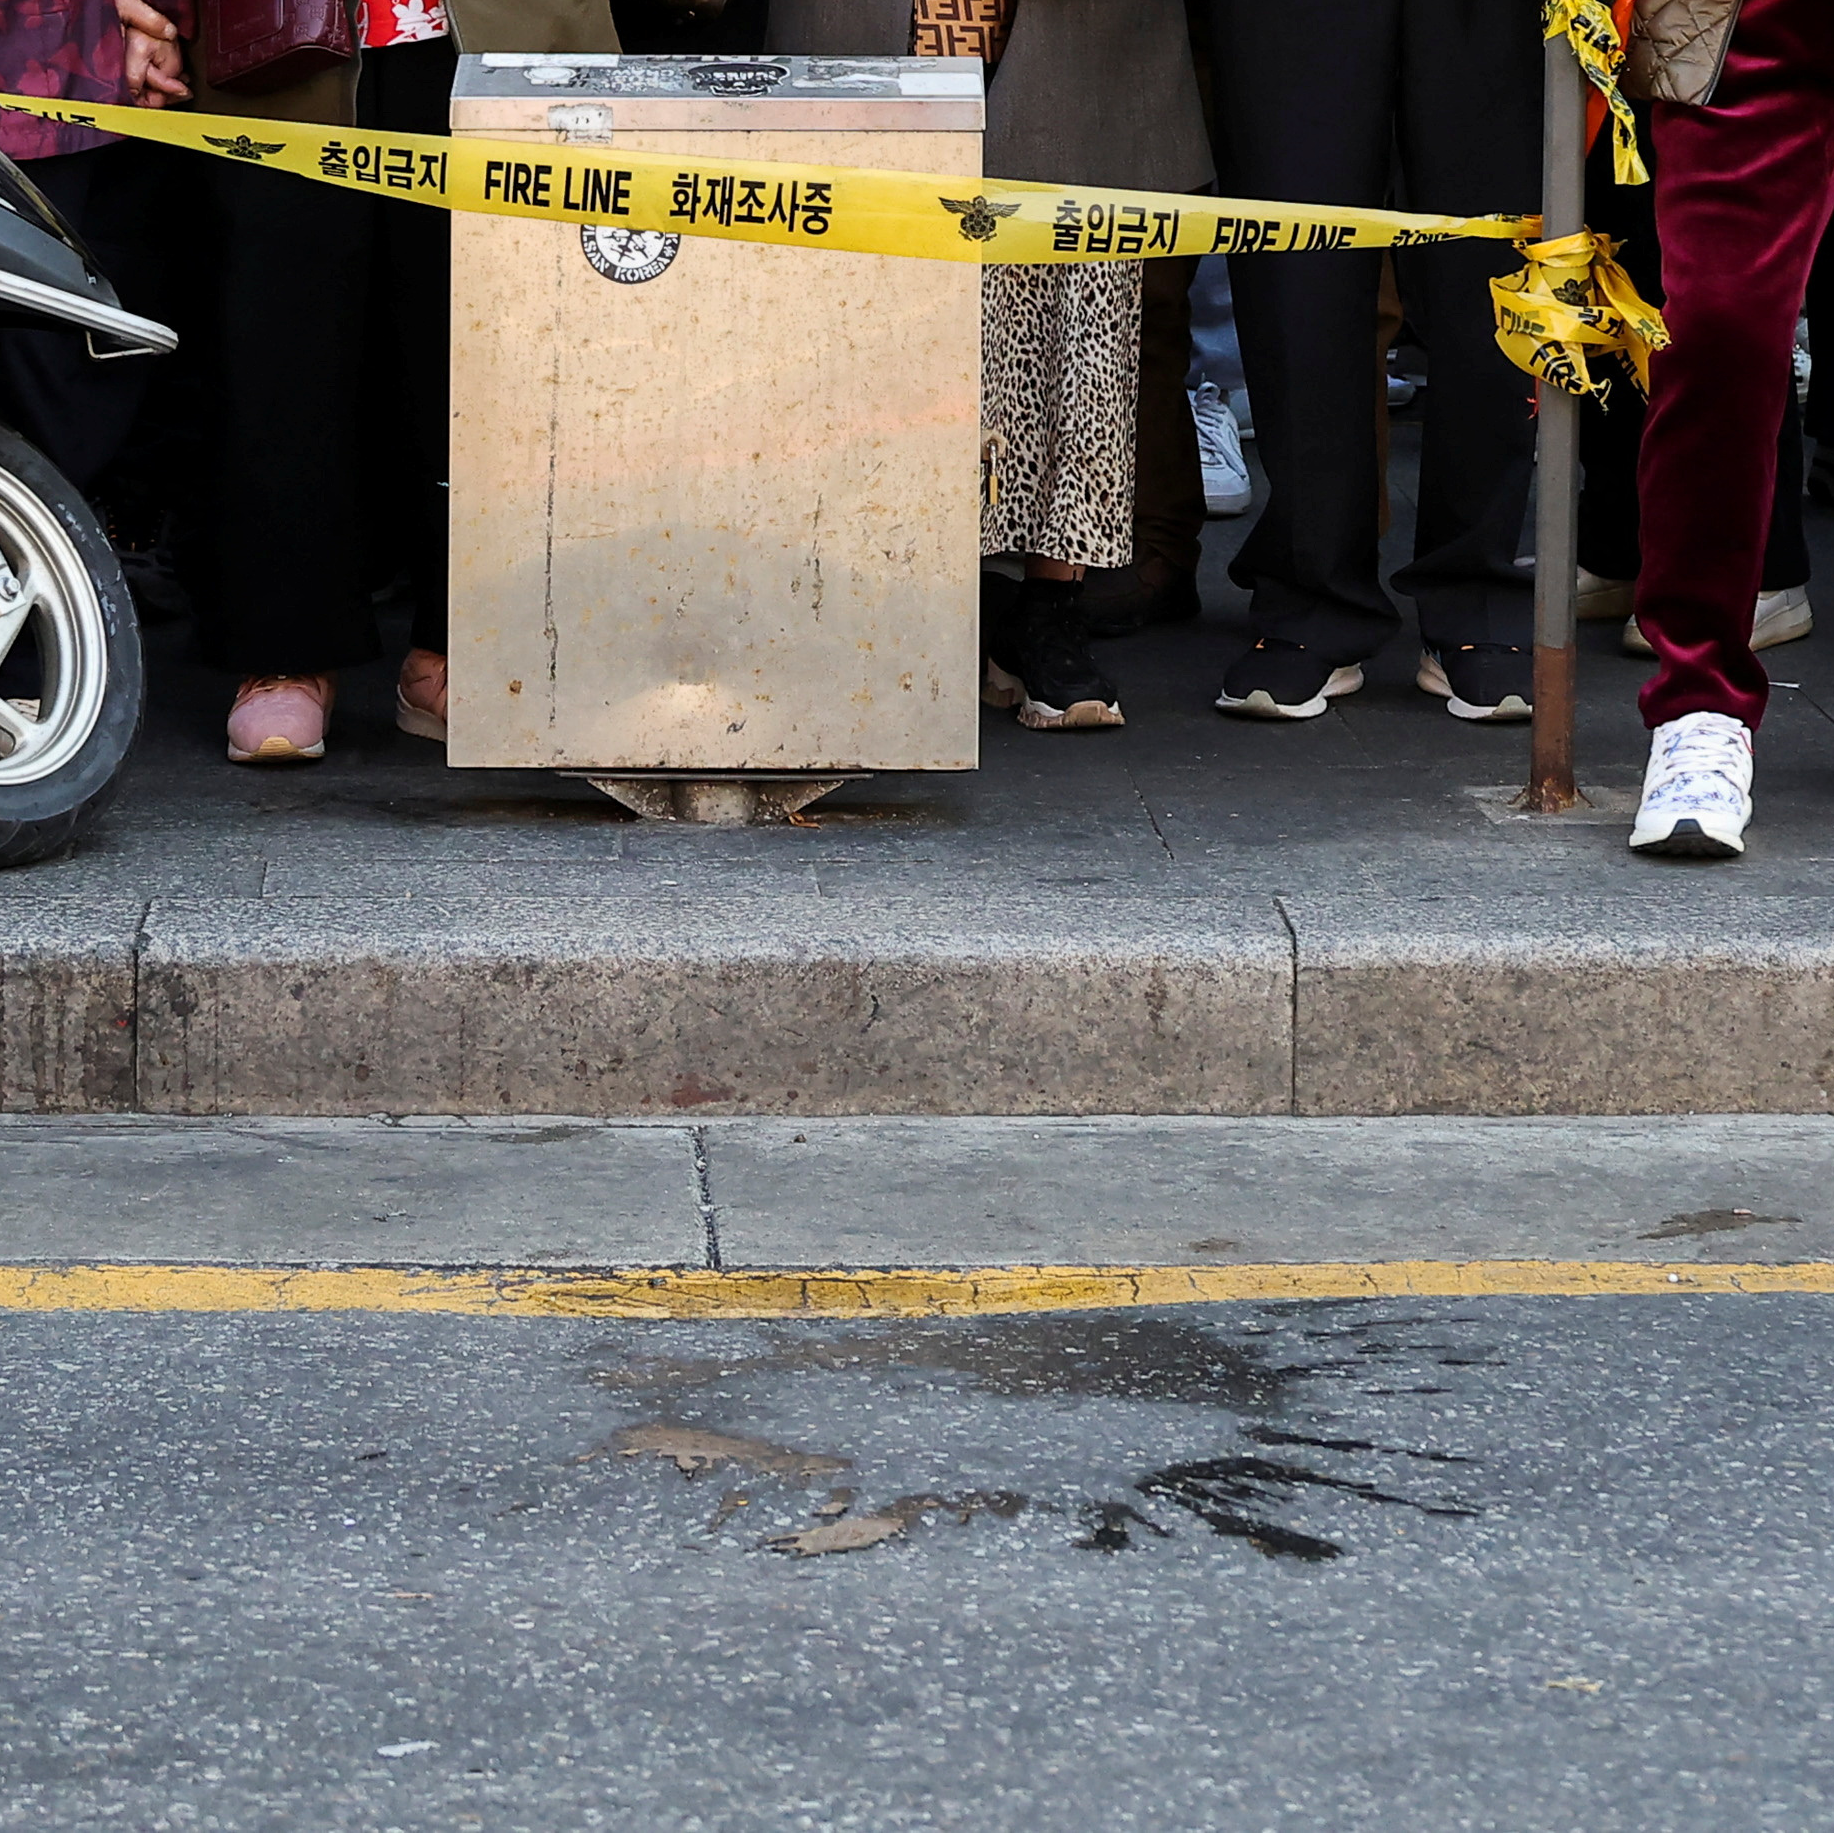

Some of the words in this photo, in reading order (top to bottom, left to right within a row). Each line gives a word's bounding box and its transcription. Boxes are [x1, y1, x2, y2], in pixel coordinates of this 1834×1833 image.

[318, 141, 448, 195] 출입금지
[484, 160, 552, 208] FIRE
[563, 166, 633, 216] LINE
[669, 172, 833, 236] 화재조사중
[1052, 199, 1180, 254] 출입금지
[1209, 217, 1279, 254] FIRE
[614, 256, 671, 282] KOREA
